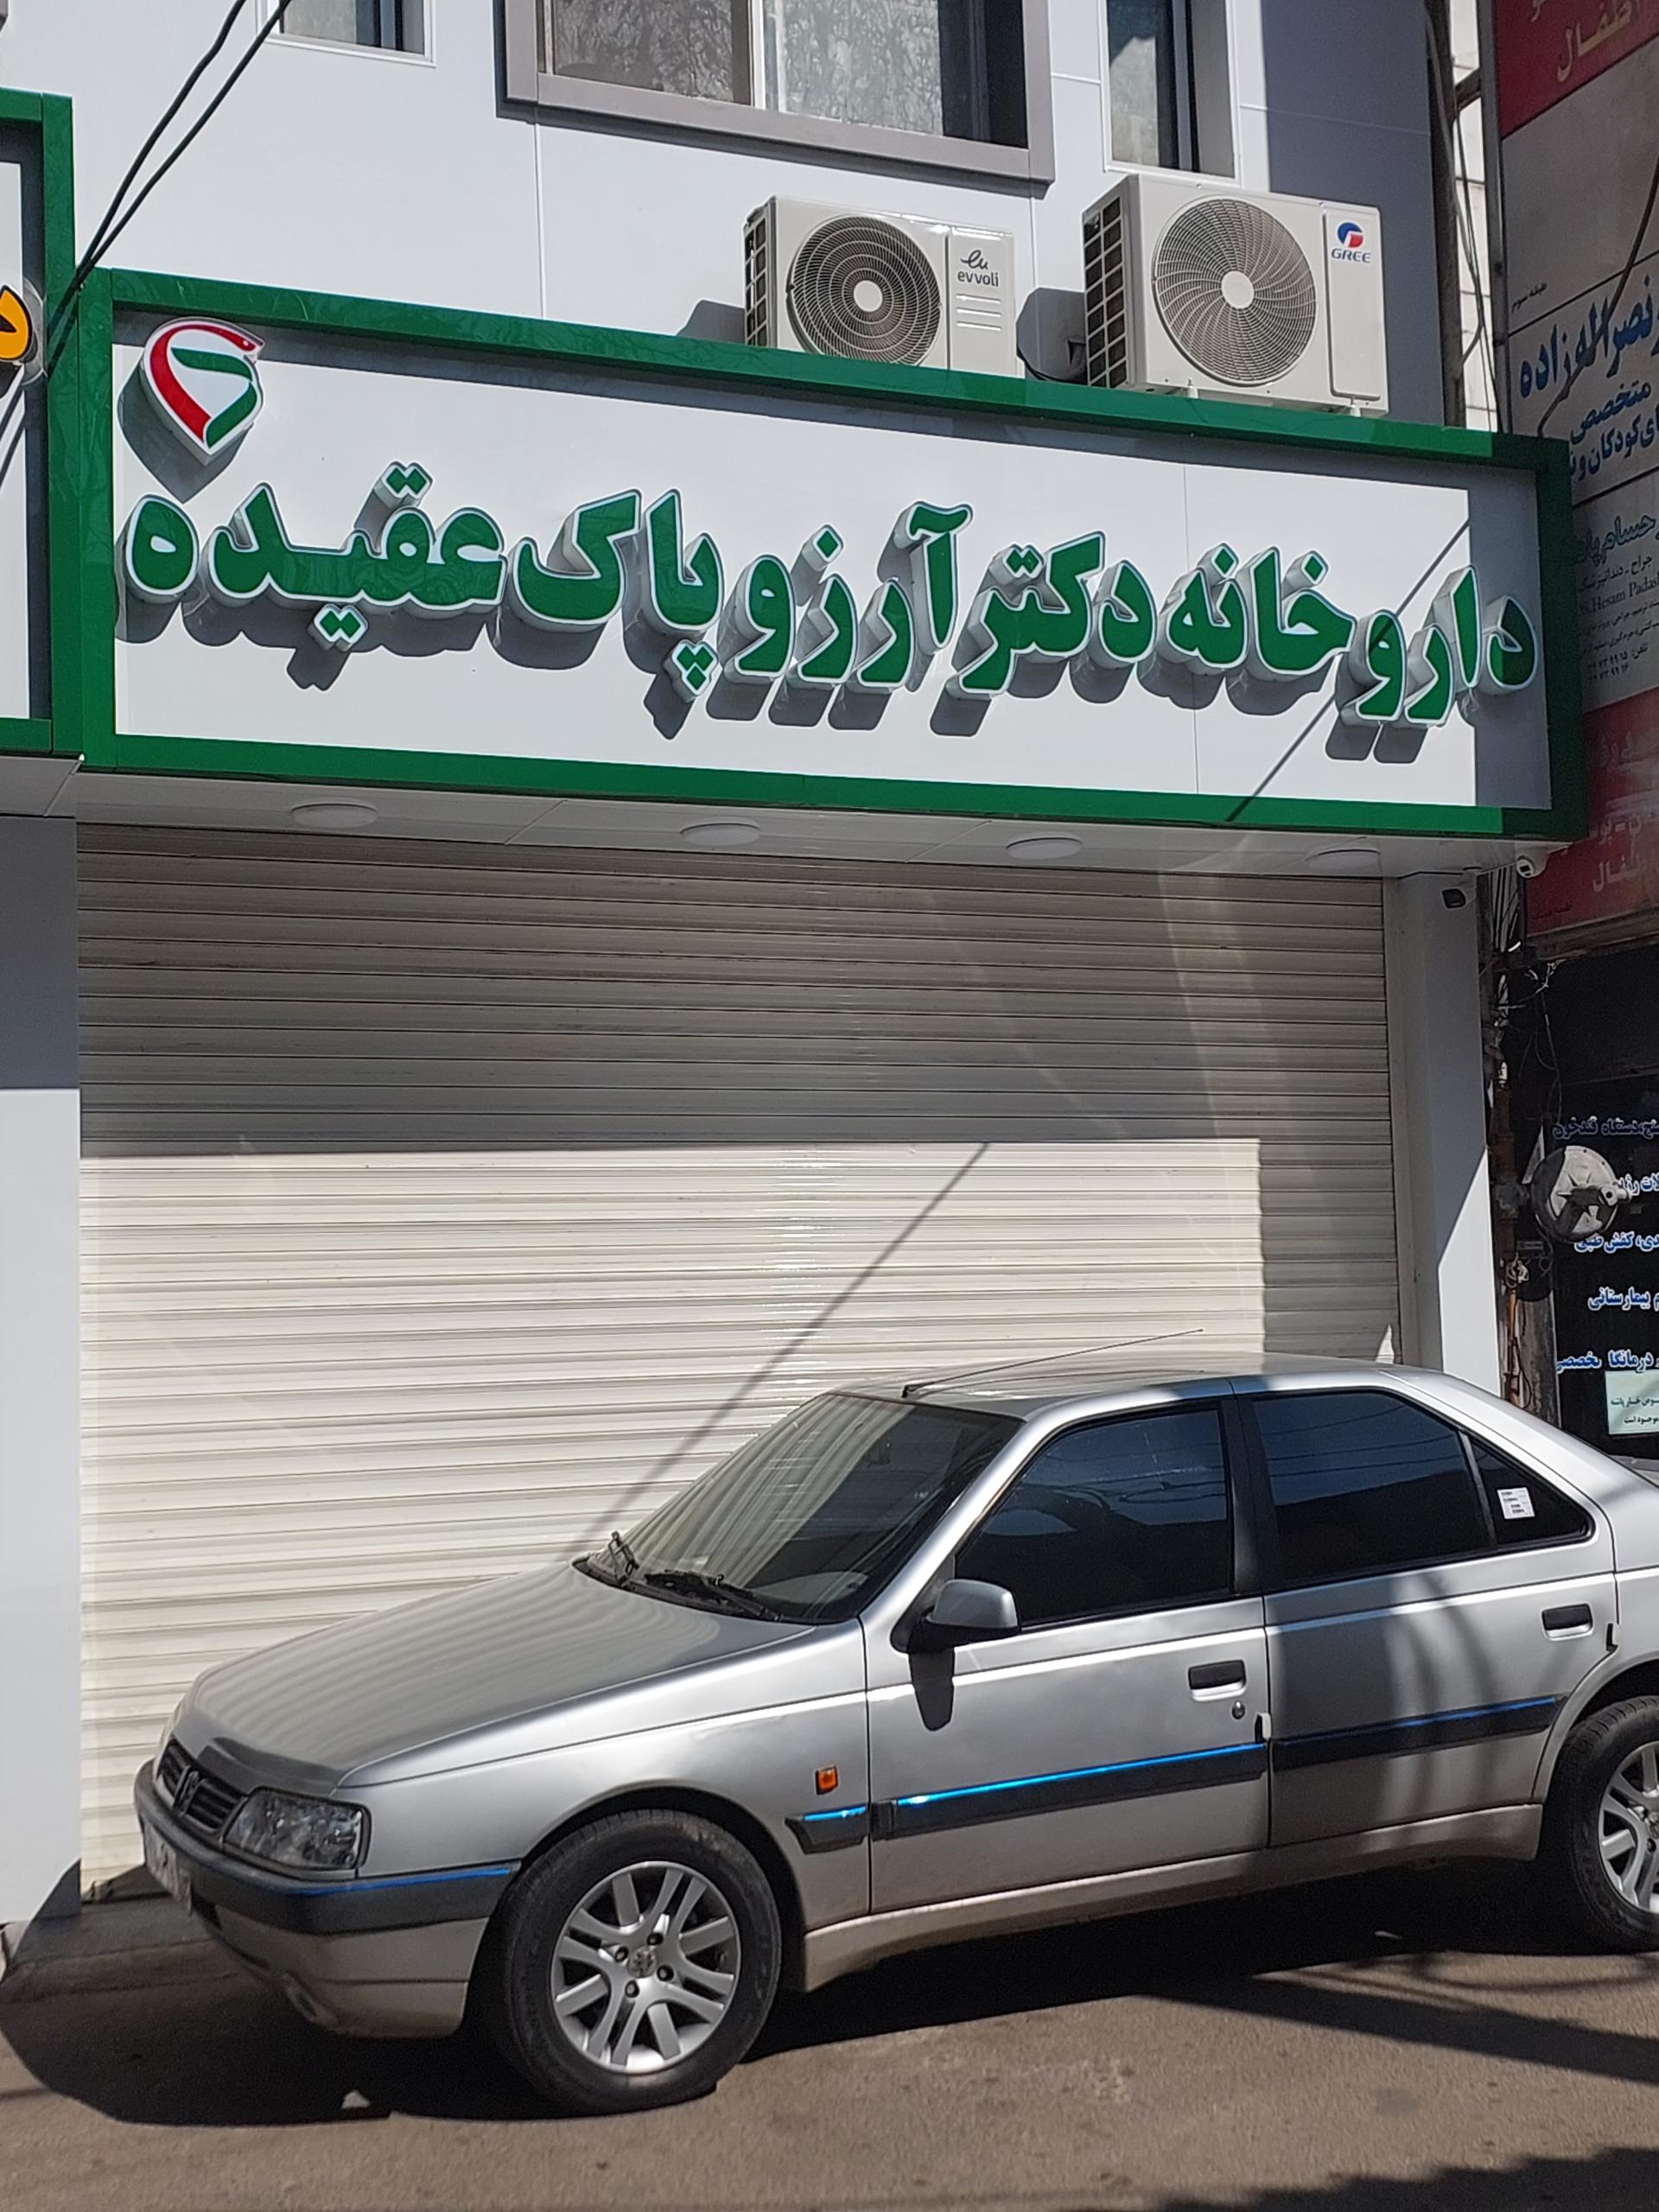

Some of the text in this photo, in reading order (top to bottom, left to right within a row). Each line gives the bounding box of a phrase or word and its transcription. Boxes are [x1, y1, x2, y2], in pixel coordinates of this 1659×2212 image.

[1331, 248, 1372, 264] GREE
[957, 270, 999, 287] evvoli
[1570, 379, 1652, 445] متخصص
[1588, 414, 1642, 474] کودکان
[1630, 555, 1653, 575] جراح
[124, 461, 1538, 723] داروخانه دکتر آرزو پاک عقیده
[1604, 1231, 1635, 1253] کفش
